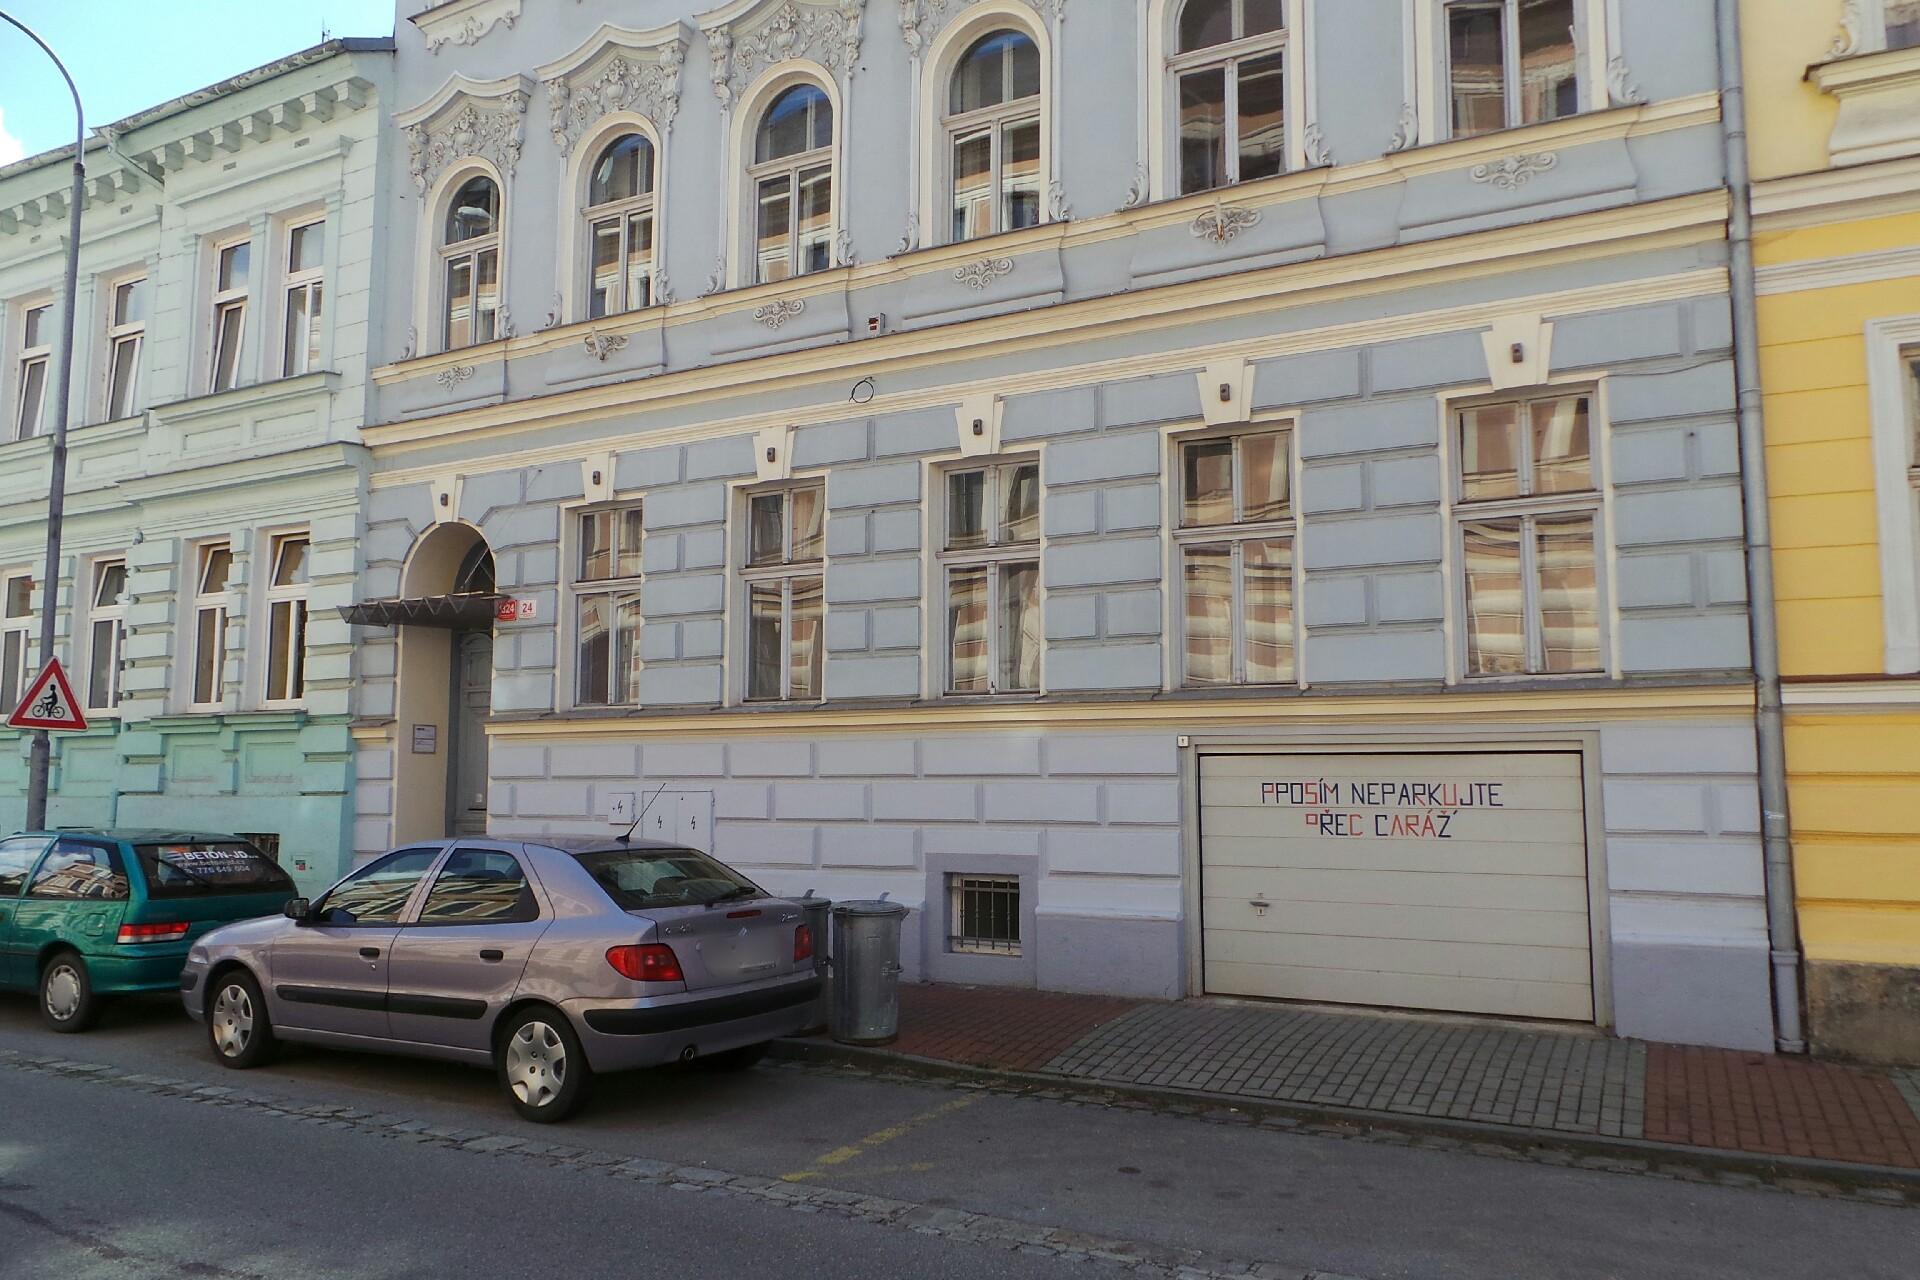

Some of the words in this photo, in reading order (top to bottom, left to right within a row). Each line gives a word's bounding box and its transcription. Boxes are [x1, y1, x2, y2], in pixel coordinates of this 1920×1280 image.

[522, 603, 533, 613] 24
[1352, 783, 1503, 807] NEPARKUJTE
[184, 851, 248, 860] BETON-JD
